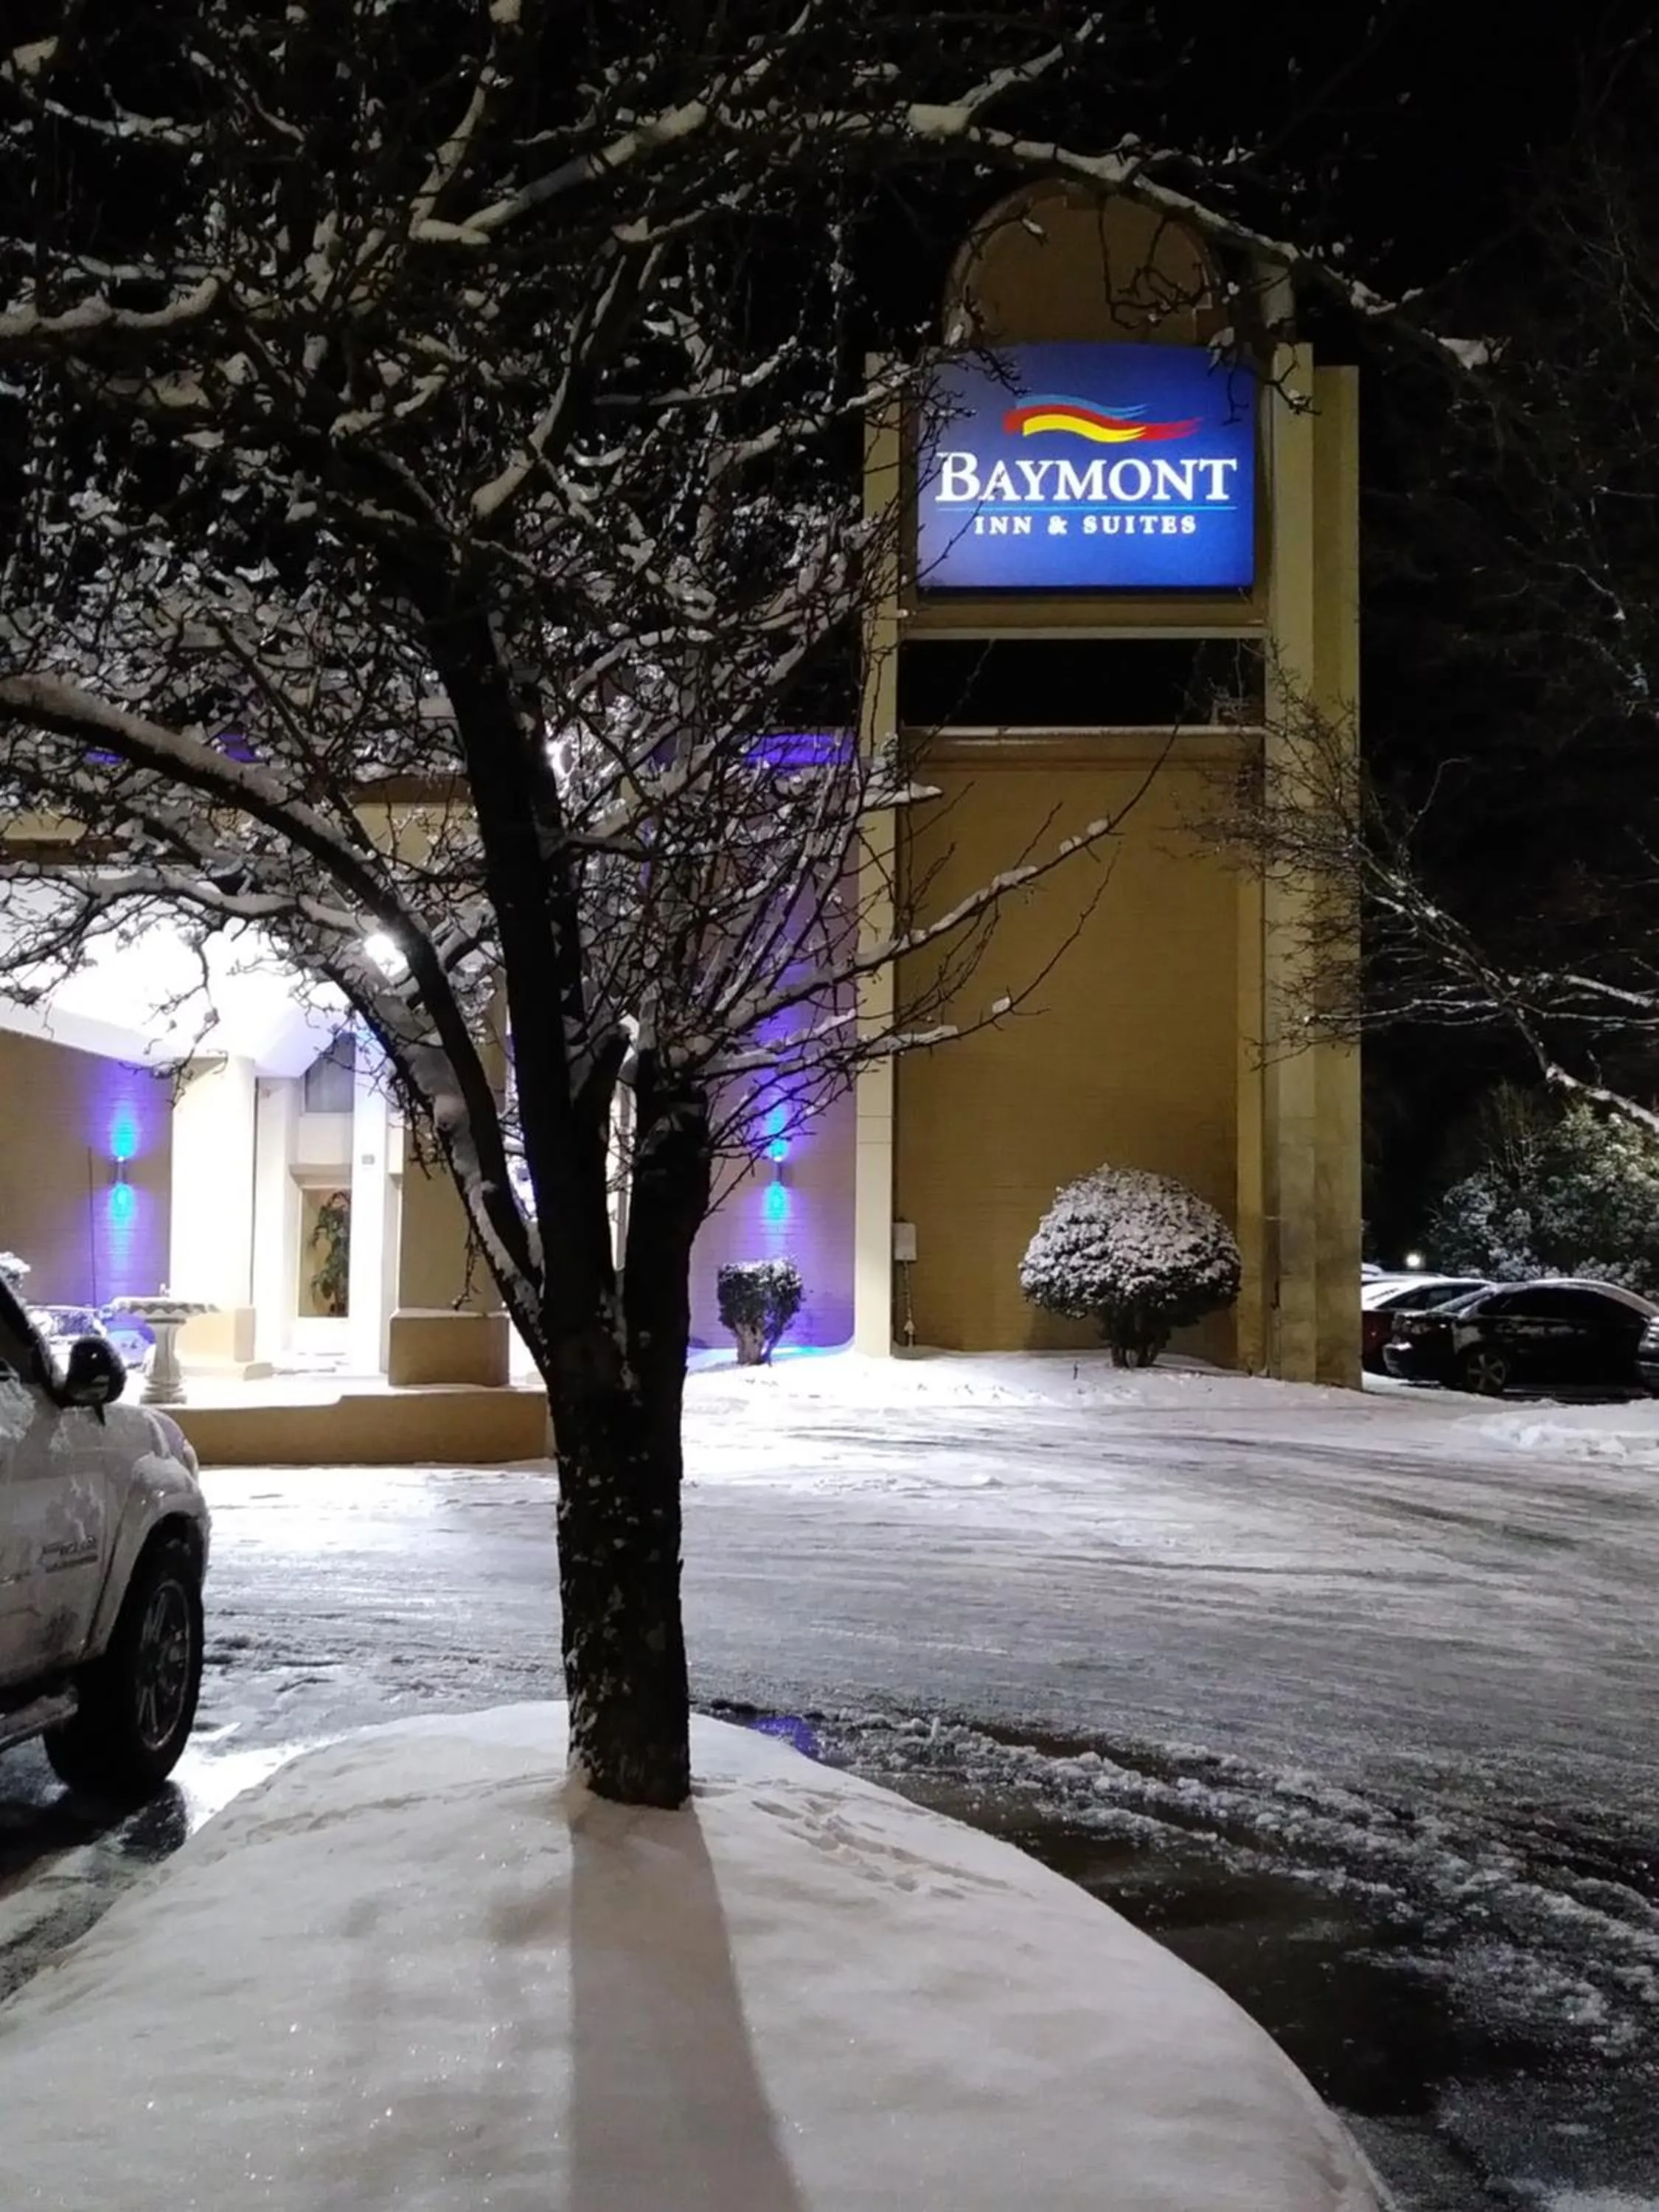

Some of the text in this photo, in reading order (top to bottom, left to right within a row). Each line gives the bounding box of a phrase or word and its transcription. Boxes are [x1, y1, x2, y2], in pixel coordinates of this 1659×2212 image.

[935, 452, 1237, 502] BAYMONT
[975, 515, 1197, 535] INN & SUITES
